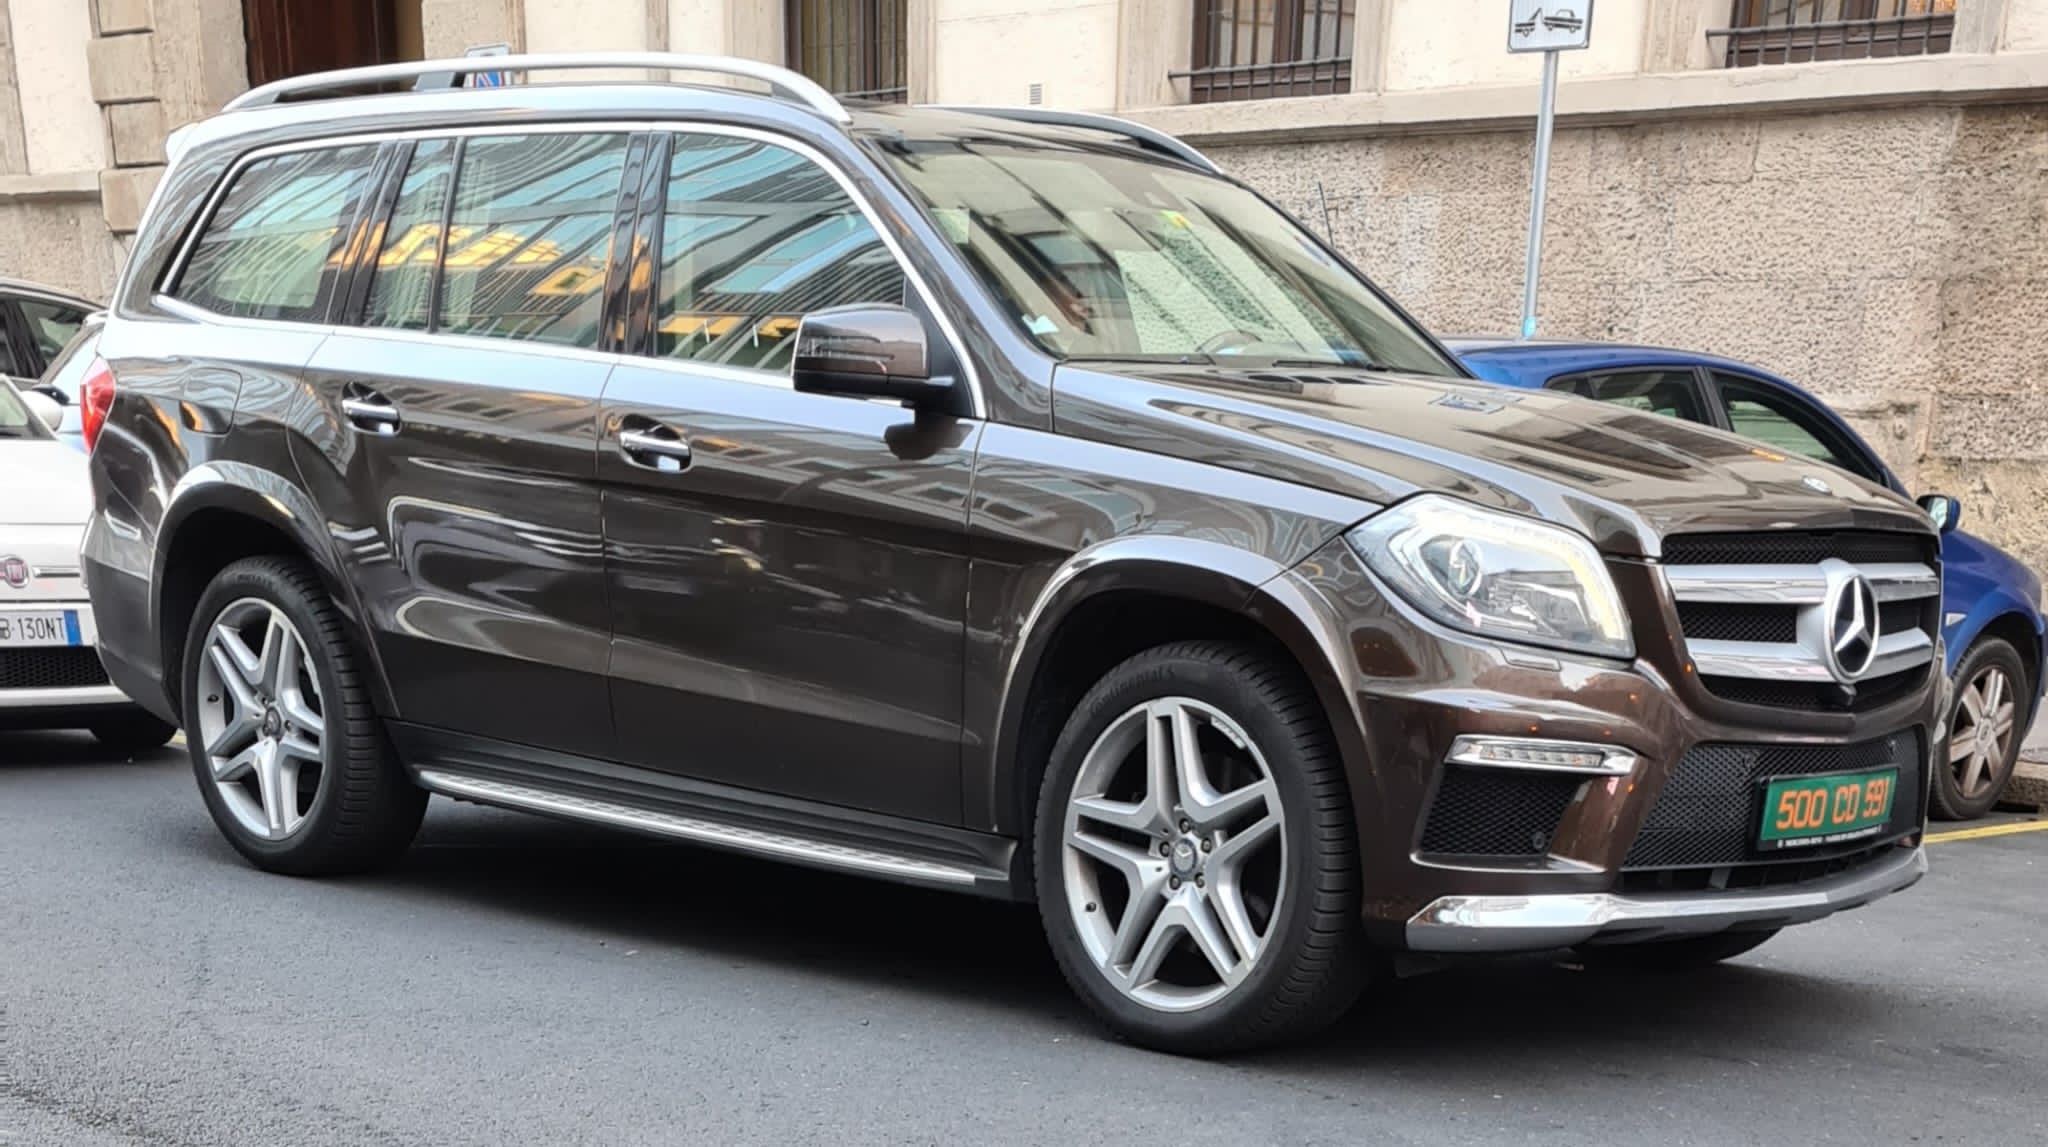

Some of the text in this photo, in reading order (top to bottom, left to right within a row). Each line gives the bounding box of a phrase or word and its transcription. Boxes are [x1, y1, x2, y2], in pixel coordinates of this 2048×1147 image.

[1776, 776, 1890, 830] 500 CD 591
